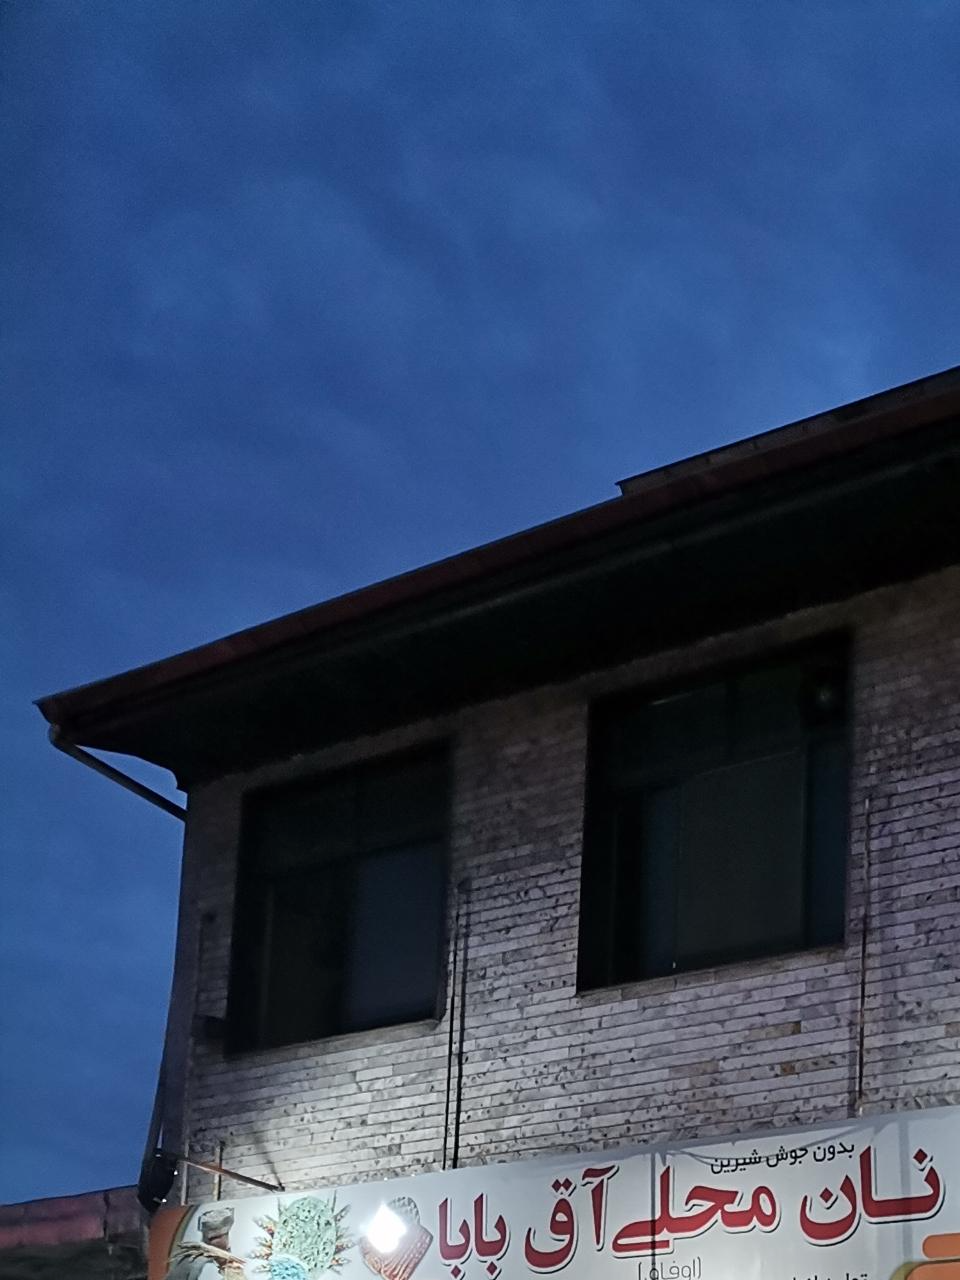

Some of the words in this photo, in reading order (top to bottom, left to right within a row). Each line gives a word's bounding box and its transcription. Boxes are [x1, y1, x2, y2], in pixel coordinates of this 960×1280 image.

[710, 1149, 761, 1174] شیرین
[766, 1146, 809, 1167] جوش
[812, 1142, 855, 1162] بدون
[524, 1164, 616, 1269] آق
[799, 1146, 941, 1241] نان
[438, 1192, 508, 1279] بابا
